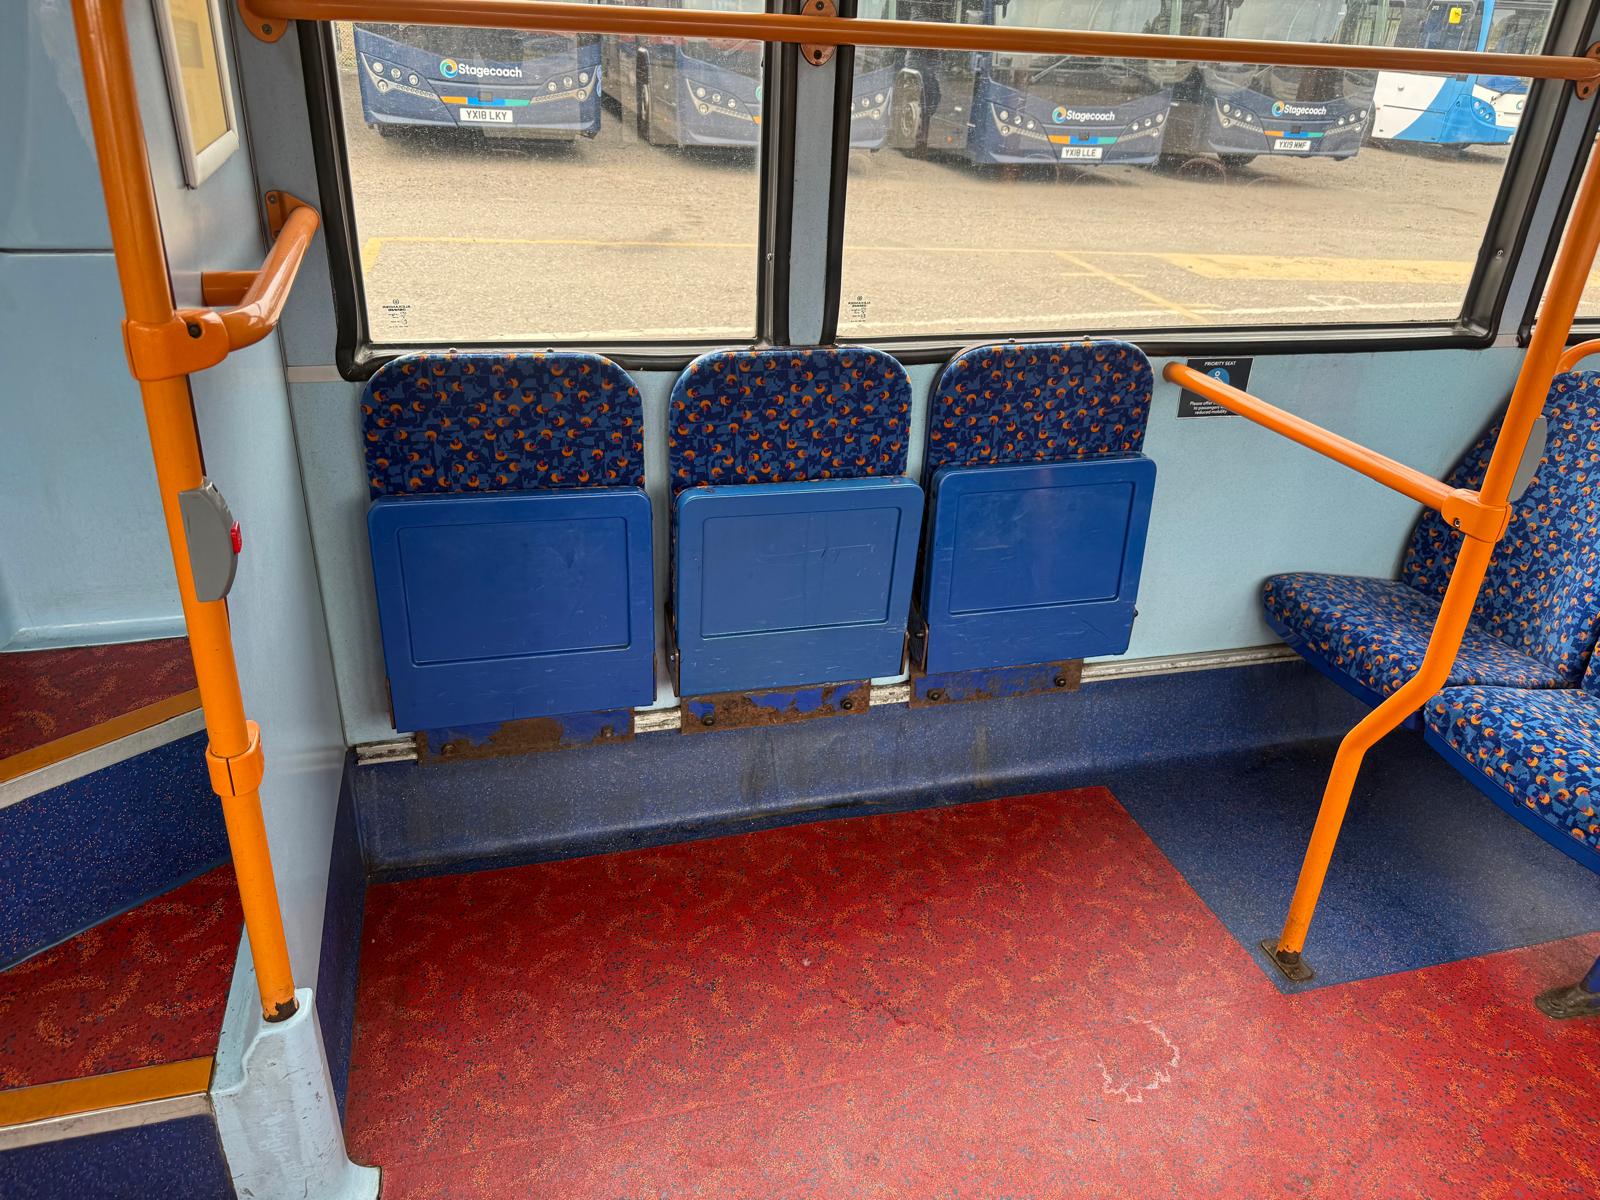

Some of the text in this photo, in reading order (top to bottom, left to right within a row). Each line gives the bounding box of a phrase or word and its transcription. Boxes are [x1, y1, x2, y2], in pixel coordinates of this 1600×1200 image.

[458, 63, 522, 78] Stagecoach
[466, 110, 507, 120] YX18 LKY
[1066, 110, 1115, 122] Stagecoach
[1284, 105, 1326, 116] Stagecoach
[1082, 149, 1096, 157] LLE
